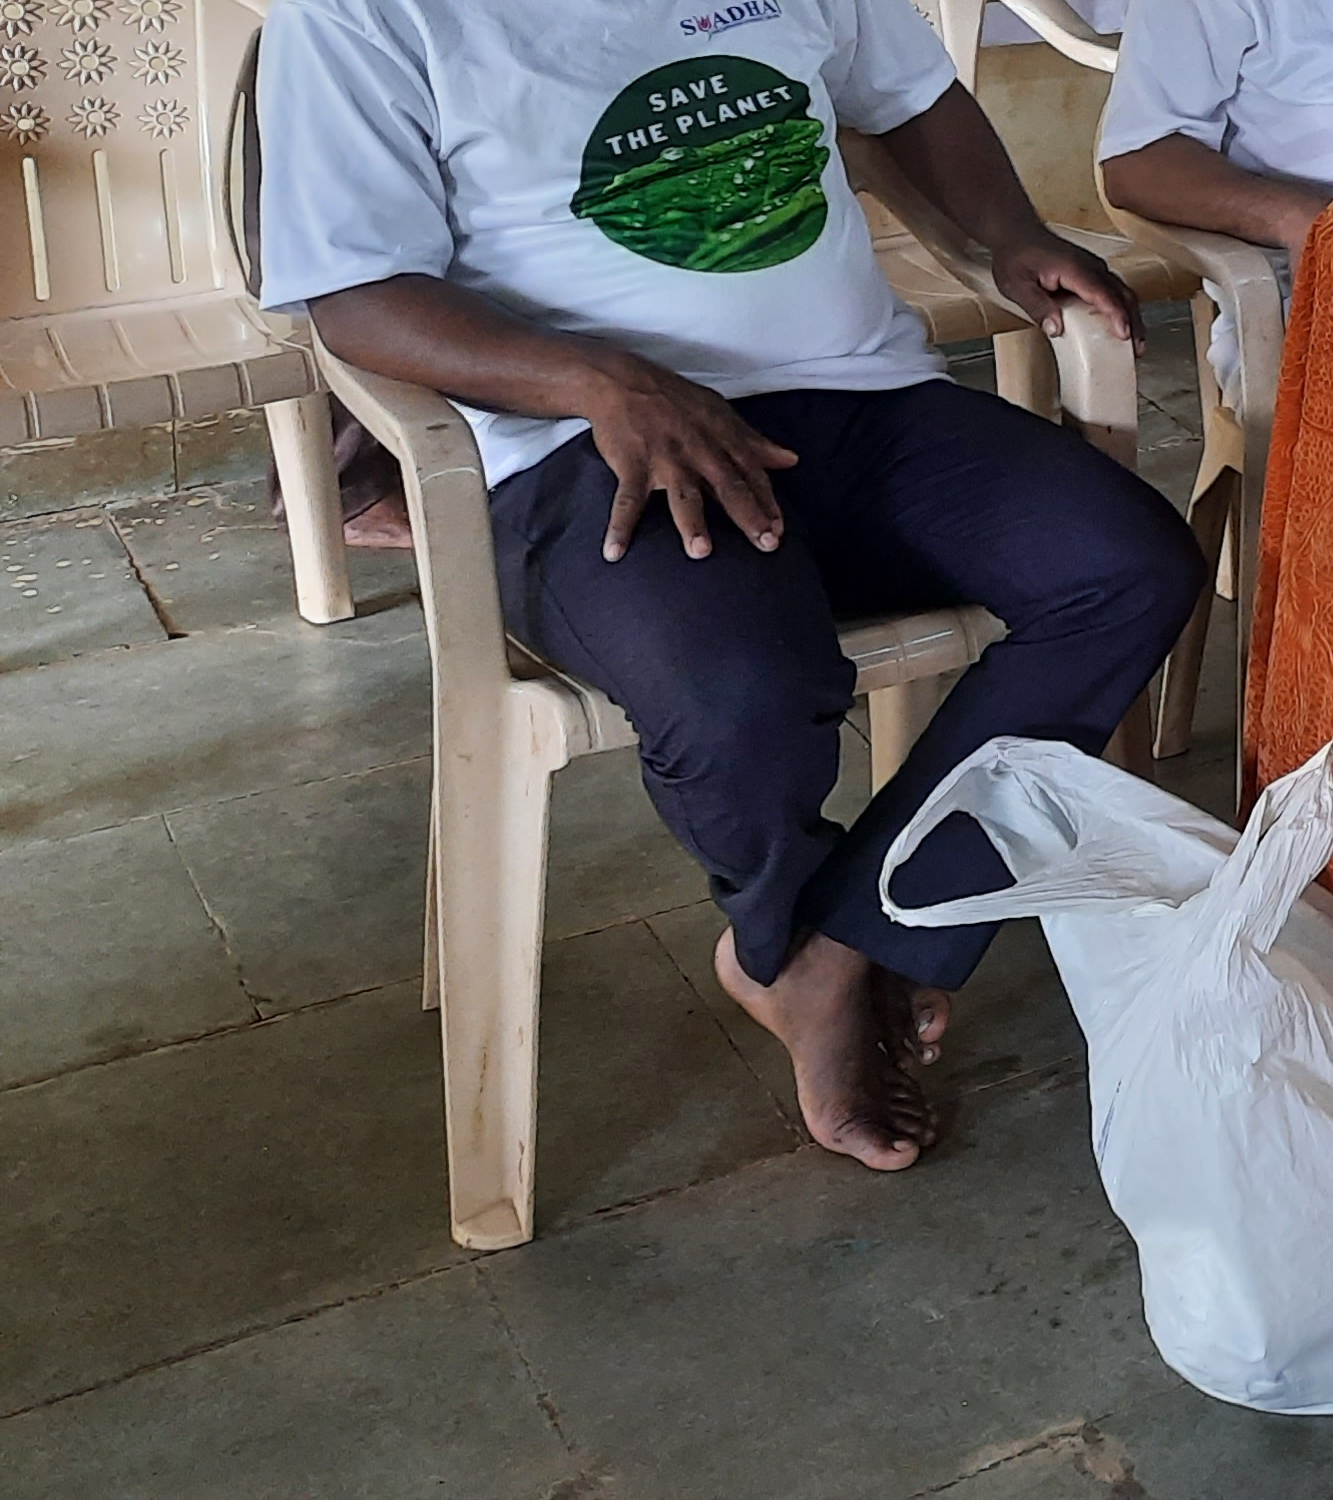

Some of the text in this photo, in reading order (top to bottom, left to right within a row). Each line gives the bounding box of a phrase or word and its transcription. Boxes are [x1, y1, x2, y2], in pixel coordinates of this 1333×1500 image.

[605, 84, 795, 157] THE PLANET
[648, 73, 729, 113] SAVE
